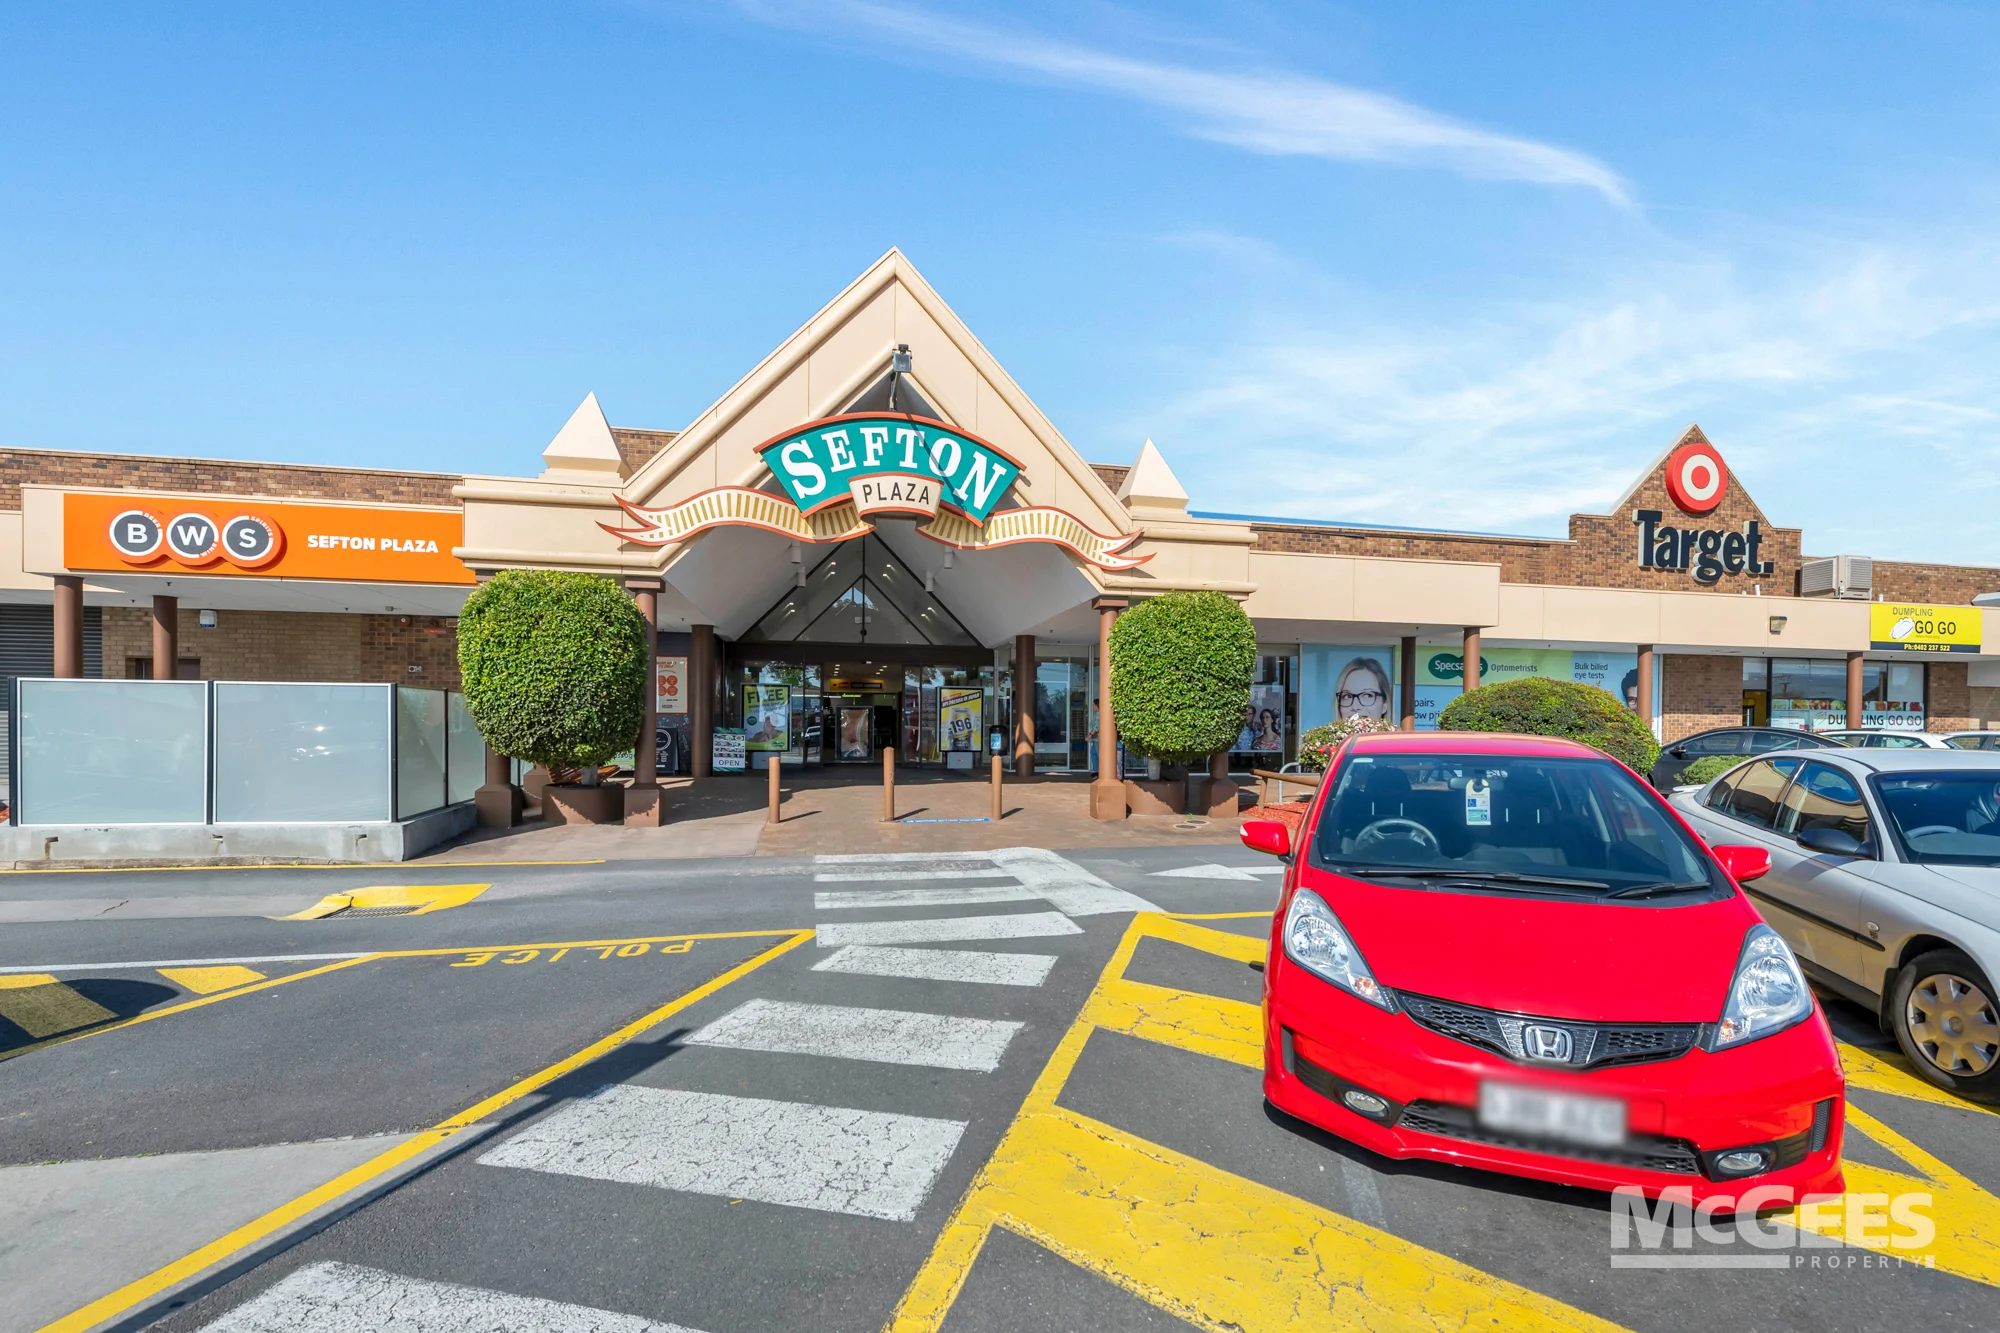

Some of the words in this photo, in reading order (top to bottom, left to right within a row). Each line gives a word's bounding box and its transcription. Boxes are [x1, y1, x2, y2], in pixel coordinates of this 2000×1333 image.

[780, 426, 1007, 510] SEFTON
[862, 482, 930, 504] PLAZA
[143, 511, 161, 528] BEER
[250, 515, 274, 538] SPIRITS
[200, 541, 218, 557] WINE
[307, 534, 376, 550] SEFTON
[380, 538, 439, 553] PLAZA
[1892, 606, 1933, 617] DUMPLING
[1914, 620, 1934, 634] GO
[1937, 621, 1957, 635] GO
[1434, 660, 1483, 672] Specsas
[1490, 663, 1538, 672] Optometrists
[1574, 662, 1589, 670] Bulk
[1590, 663, 1608, 671] billed
[1574, 672, 1587, 680] eye
[1828, 714, 1884, 725] DULING
[1888, 715, 1903, 725] GO
[1906, 716, 1922, 726] GO
[449, 939, 695, 967] POLICE
